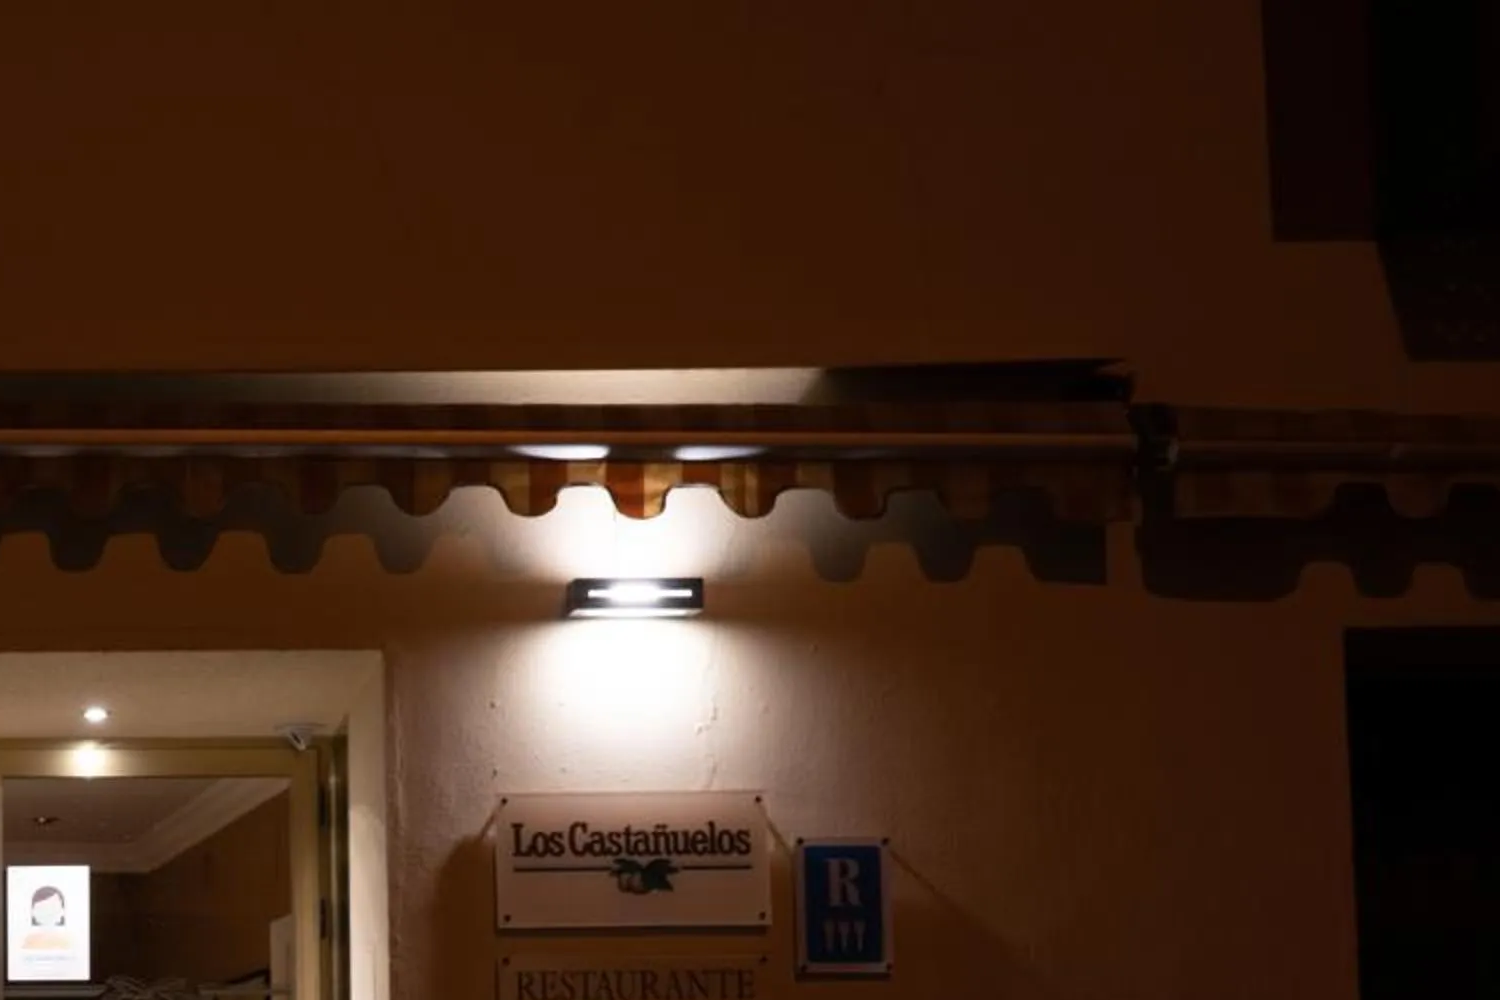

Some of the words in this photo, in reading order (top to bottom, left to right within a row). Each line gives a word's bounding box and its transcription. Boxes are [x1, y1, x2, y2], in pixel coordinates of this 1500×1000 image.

[511, 823, 566, 858] Los
[569, 821, 752, 857] Castañuelos
[825, 857, 862, 907] R
